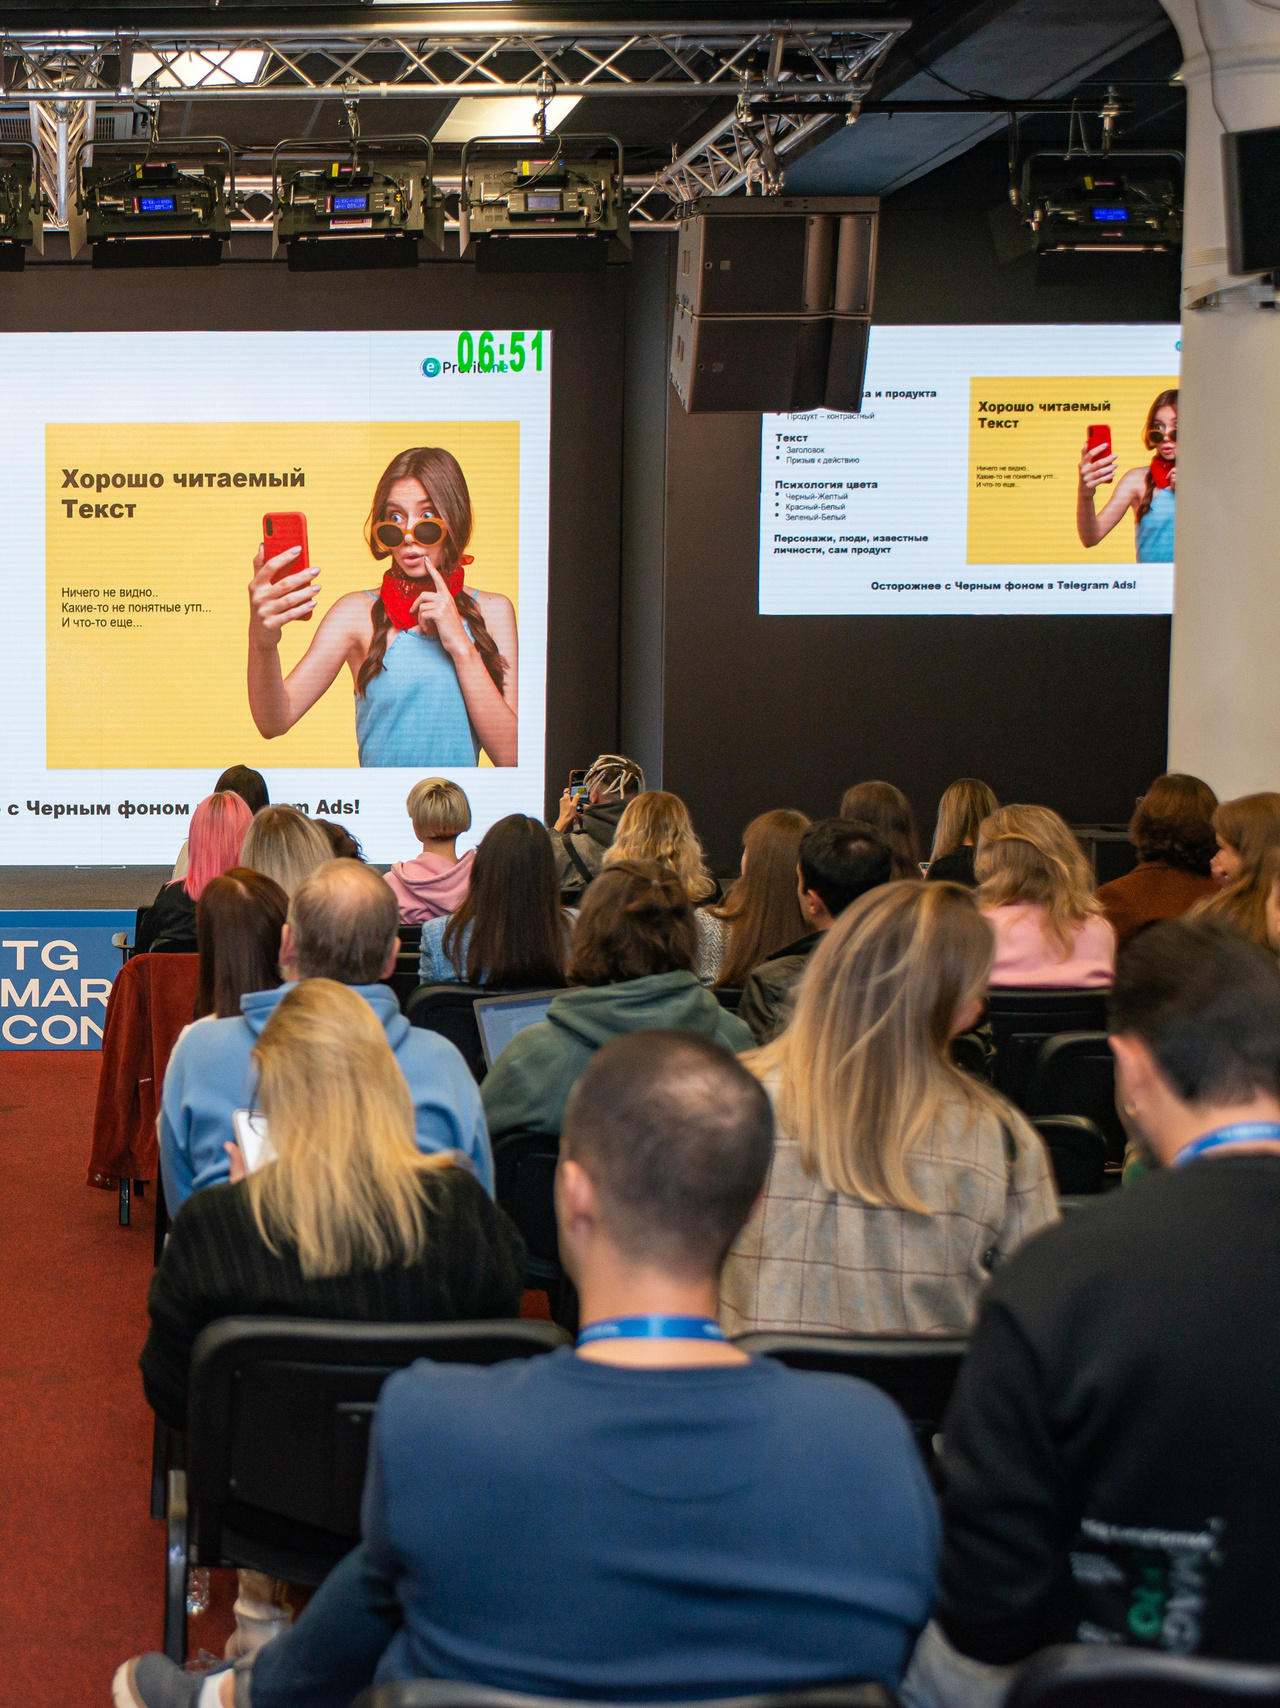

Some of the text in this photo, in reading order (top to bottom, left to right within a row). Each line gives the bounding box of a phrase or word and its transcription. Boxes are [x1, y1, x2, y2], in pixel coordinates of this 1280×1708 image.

[457, 330, 543, 373] 06:51
[874, 390, 883, 398] и
[884, 390, 938, 401] продукта
[977, 400, 1111, 415] Хорошо читаемый
[786, 412, 819, 422] Продукт
[826, 412, 875, 421] контрастный
[977, 417, 1020, 429] Текст
[775, 433, 809, 443] Текст
[786, 445, 826, 454] Заголовок
[786, 455, 816, 466] Призыв
[822, 456, 860, 465] действию
[60, 466, 306, 493] Хорошо читаемый
[774, 479, 879, 491] Психология цвета
[785, 492, 849, 502] Черный-Желтый
[60, 498, 137, 520] Текст
[785, 502, 846, 512] Красный-Белый
[785, 512, 847, 522] Зеленый-Белый
[773, 533, 929, 545] Персонажи, люди, известные
[773, 547, 826, 556] личности,
[850, 547, 892, 556] продукт
[61, 586, 159, 599] Ничего не видно..
[870, 580, 1137, 593] Осторожнее с Черным фоном в Telegram Ads!
[61, 602, 212, 616] Какие-то не понятные утп...
[61, 616, 143, 629] И что-то еще...
[7, 803, 20, 816] с
[26, 799, 111, 820] Черным
[117, 799, 190, 820] фоном
[315, 798, 360, 815] Ads!
[2, 939, 79, 971] TG
[1, 978, 111, 1008] MAR
[2, 1014, 105, 1045] CON
